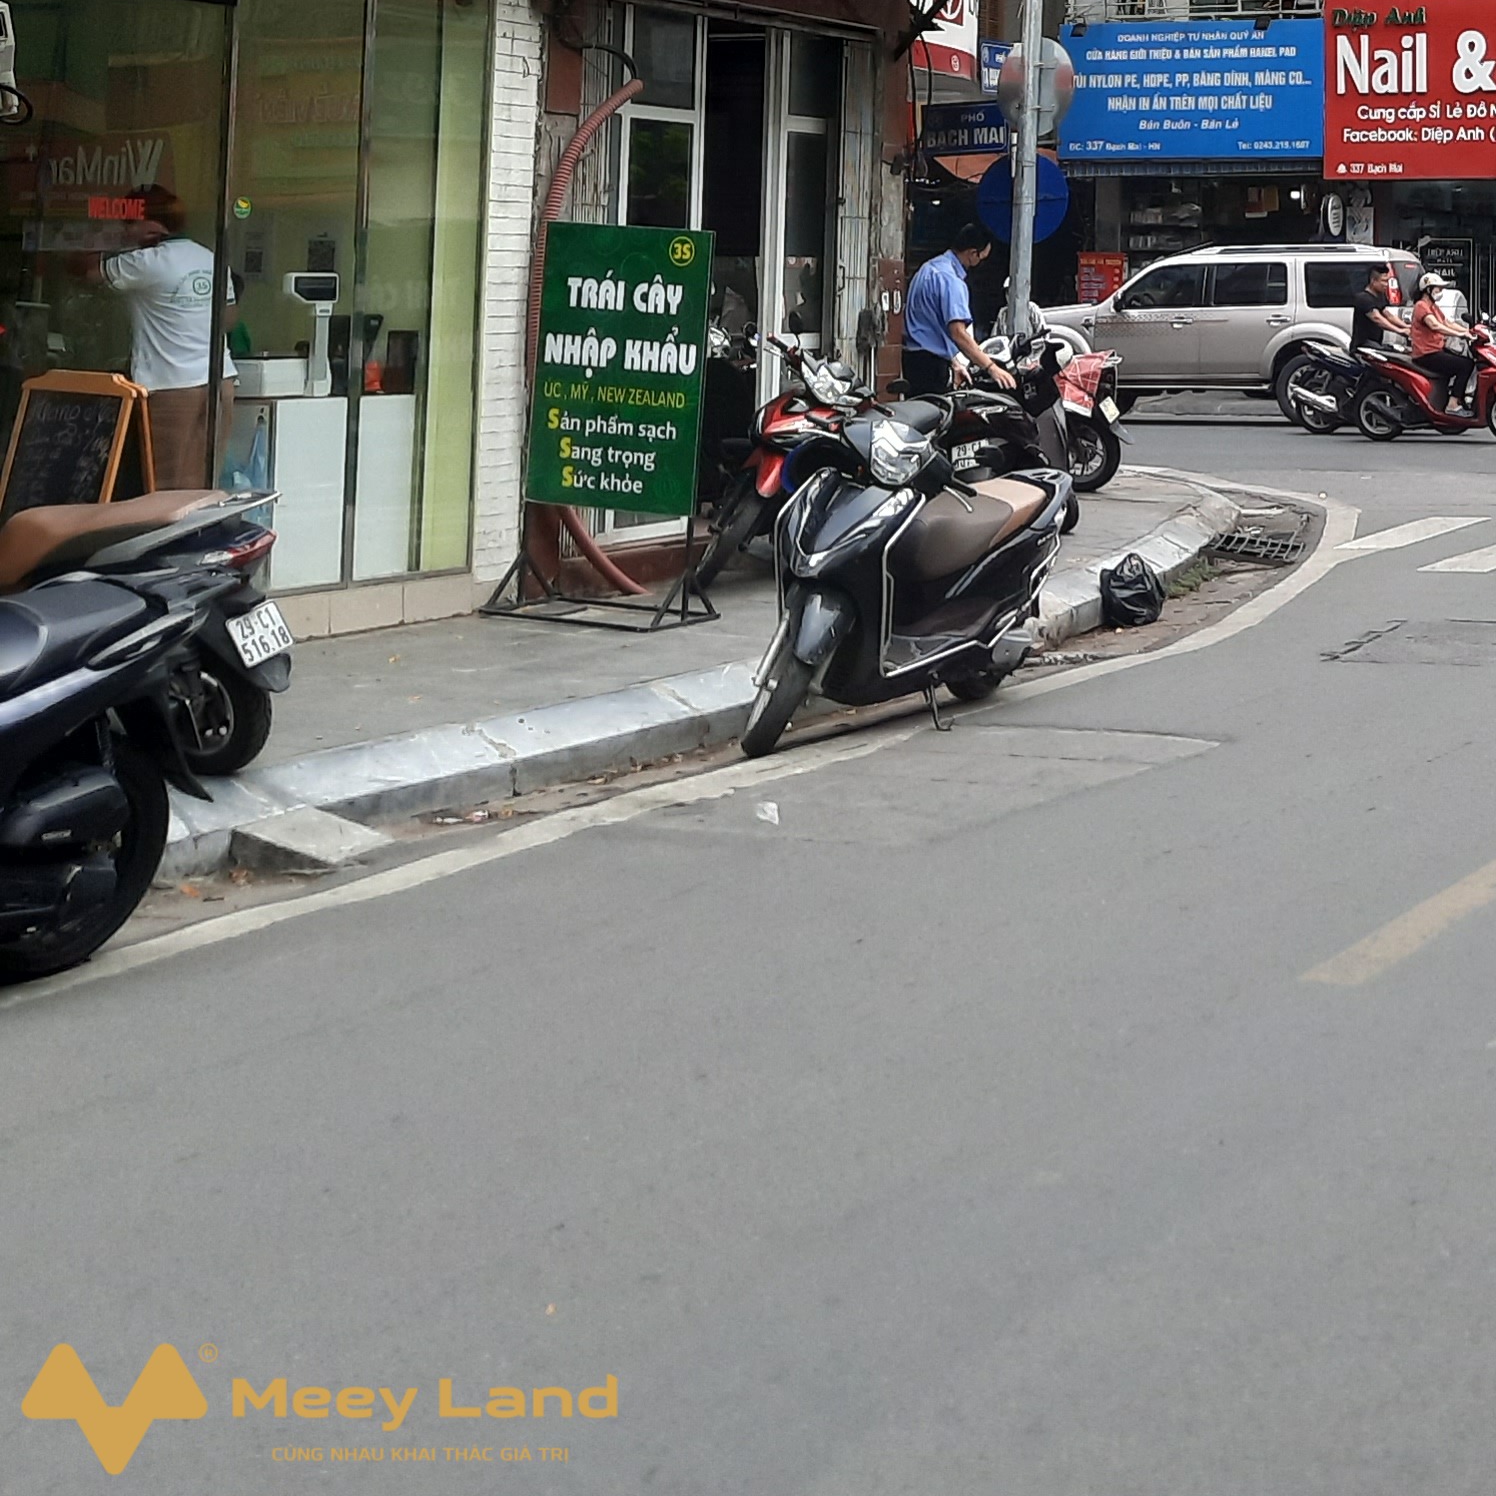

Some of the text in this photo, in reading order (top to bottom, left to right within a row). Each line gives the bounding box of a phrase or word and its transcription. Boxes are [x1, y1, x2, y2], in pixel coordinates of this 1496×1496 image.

[1336, 32, 1428, 95] Nail
[1089, 74, 1122, 88] NYLON
[1124, 74, 1140, 89] PE,
[1143, 73, 1173, 88] HDPE,
[1175, 73, 1190, 88] PP,
[1107, 94, 1136, 114] NHẬN
[1138, 96, 1151, 111] IN
[1169, 93, 1195, 110] TRÊN
[1198, 95, 1218, 113] MỌI
[1221, 91, 1248, 110] CHẤT
[1249, 92, 1273, 113] LIỆU
[1356, 106, 1395, 123] Cung
[1398, 101, 1426, 122] cấp
[961, 110, 985, 122] PHỐ
[1163, 118, 1191, 130] Buôn
[927, 126, 1005, 150] BẠCH MAI
[1086, 140, 1105, 151] 337
[1343, 127, 1417, 143] Facebook:
[1421, 126, 1453, 144] Diệp
[1456, 126, 1484, 141] Anh
[88, 196, 146, 221] WELCOME
[673, 243, 691, 260] 3S
[567, 269, 684, 316] TRÁI CÂY
[544, 326, 697, 378] NHẬP KHẨU
[597, 385, 626, 404] NEW
[627, 388, 686, 409] ZEALAND
[547, 407, 677, 443] Sản phẩm sạch
[559, 436, 657, 472] Sang trọng
[561, 465, 643, 495] Sức khỏe
[240, 625, 290, 662] 516.18
